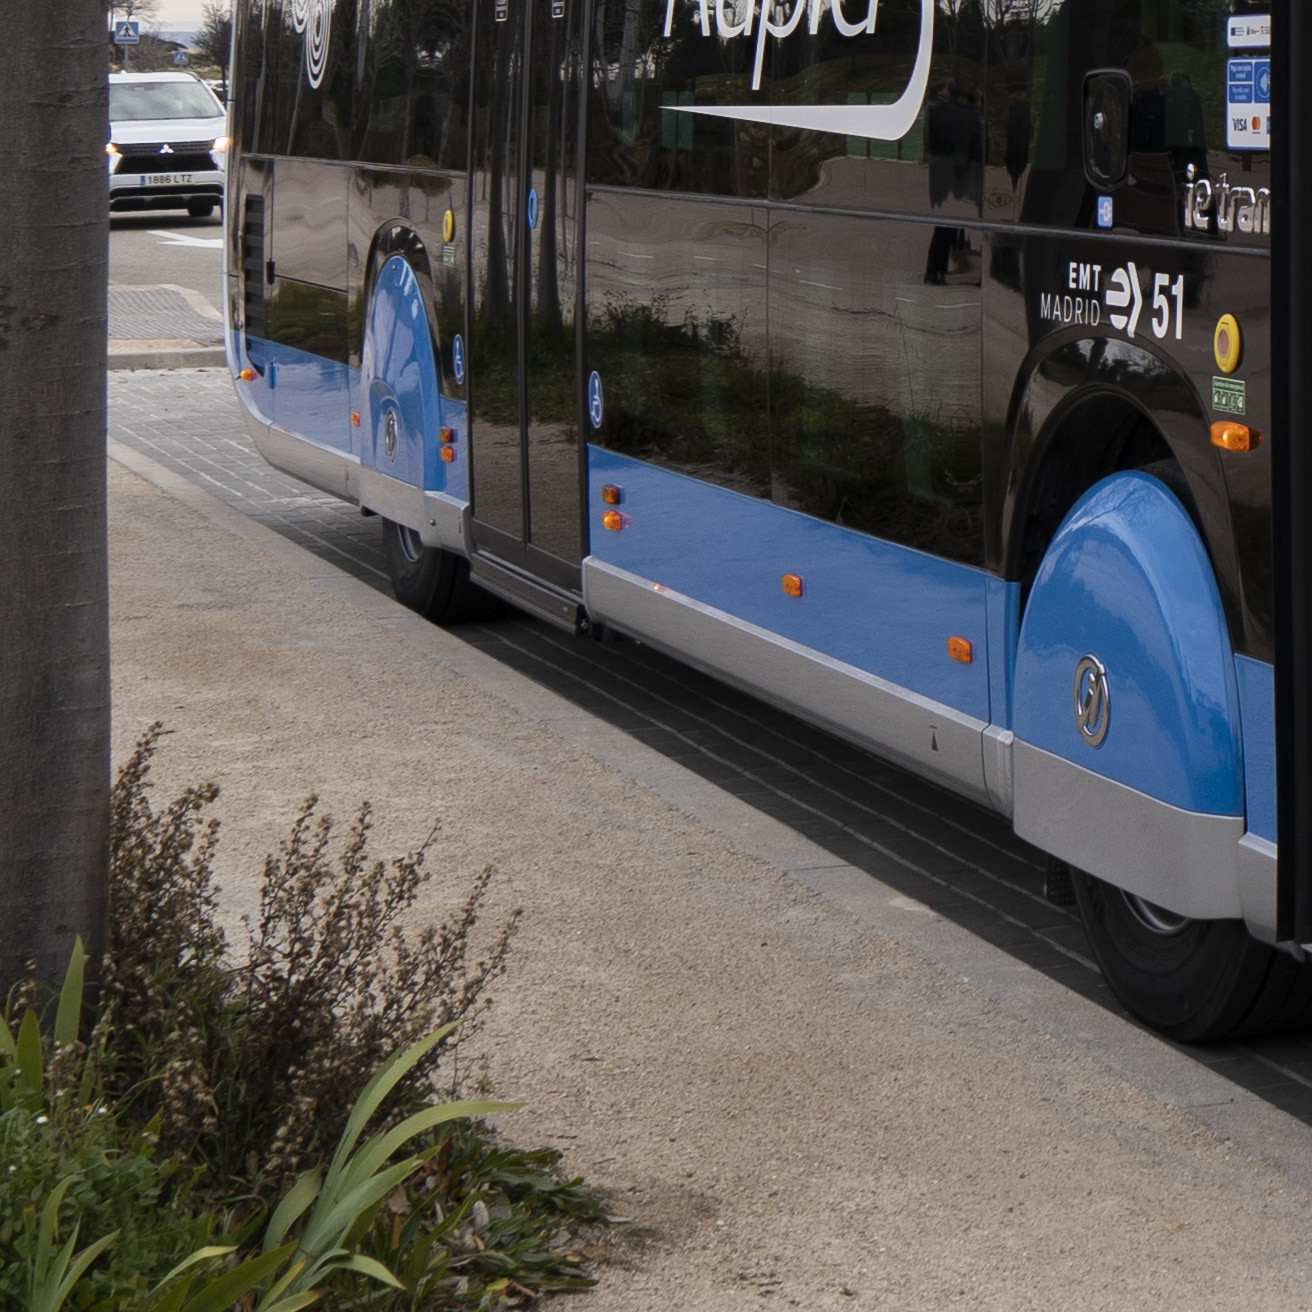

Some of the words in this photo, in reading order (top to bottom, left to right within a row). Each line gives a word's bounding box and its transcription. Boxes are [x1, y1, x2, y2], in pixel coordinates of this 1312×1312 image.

[1232, 118, 1248, 131] VISA
[1069, 262, 1101, 292] EMT
[1040, 292, 1100, 327] MADRID
[1152, 272, 1184, 340] 51
